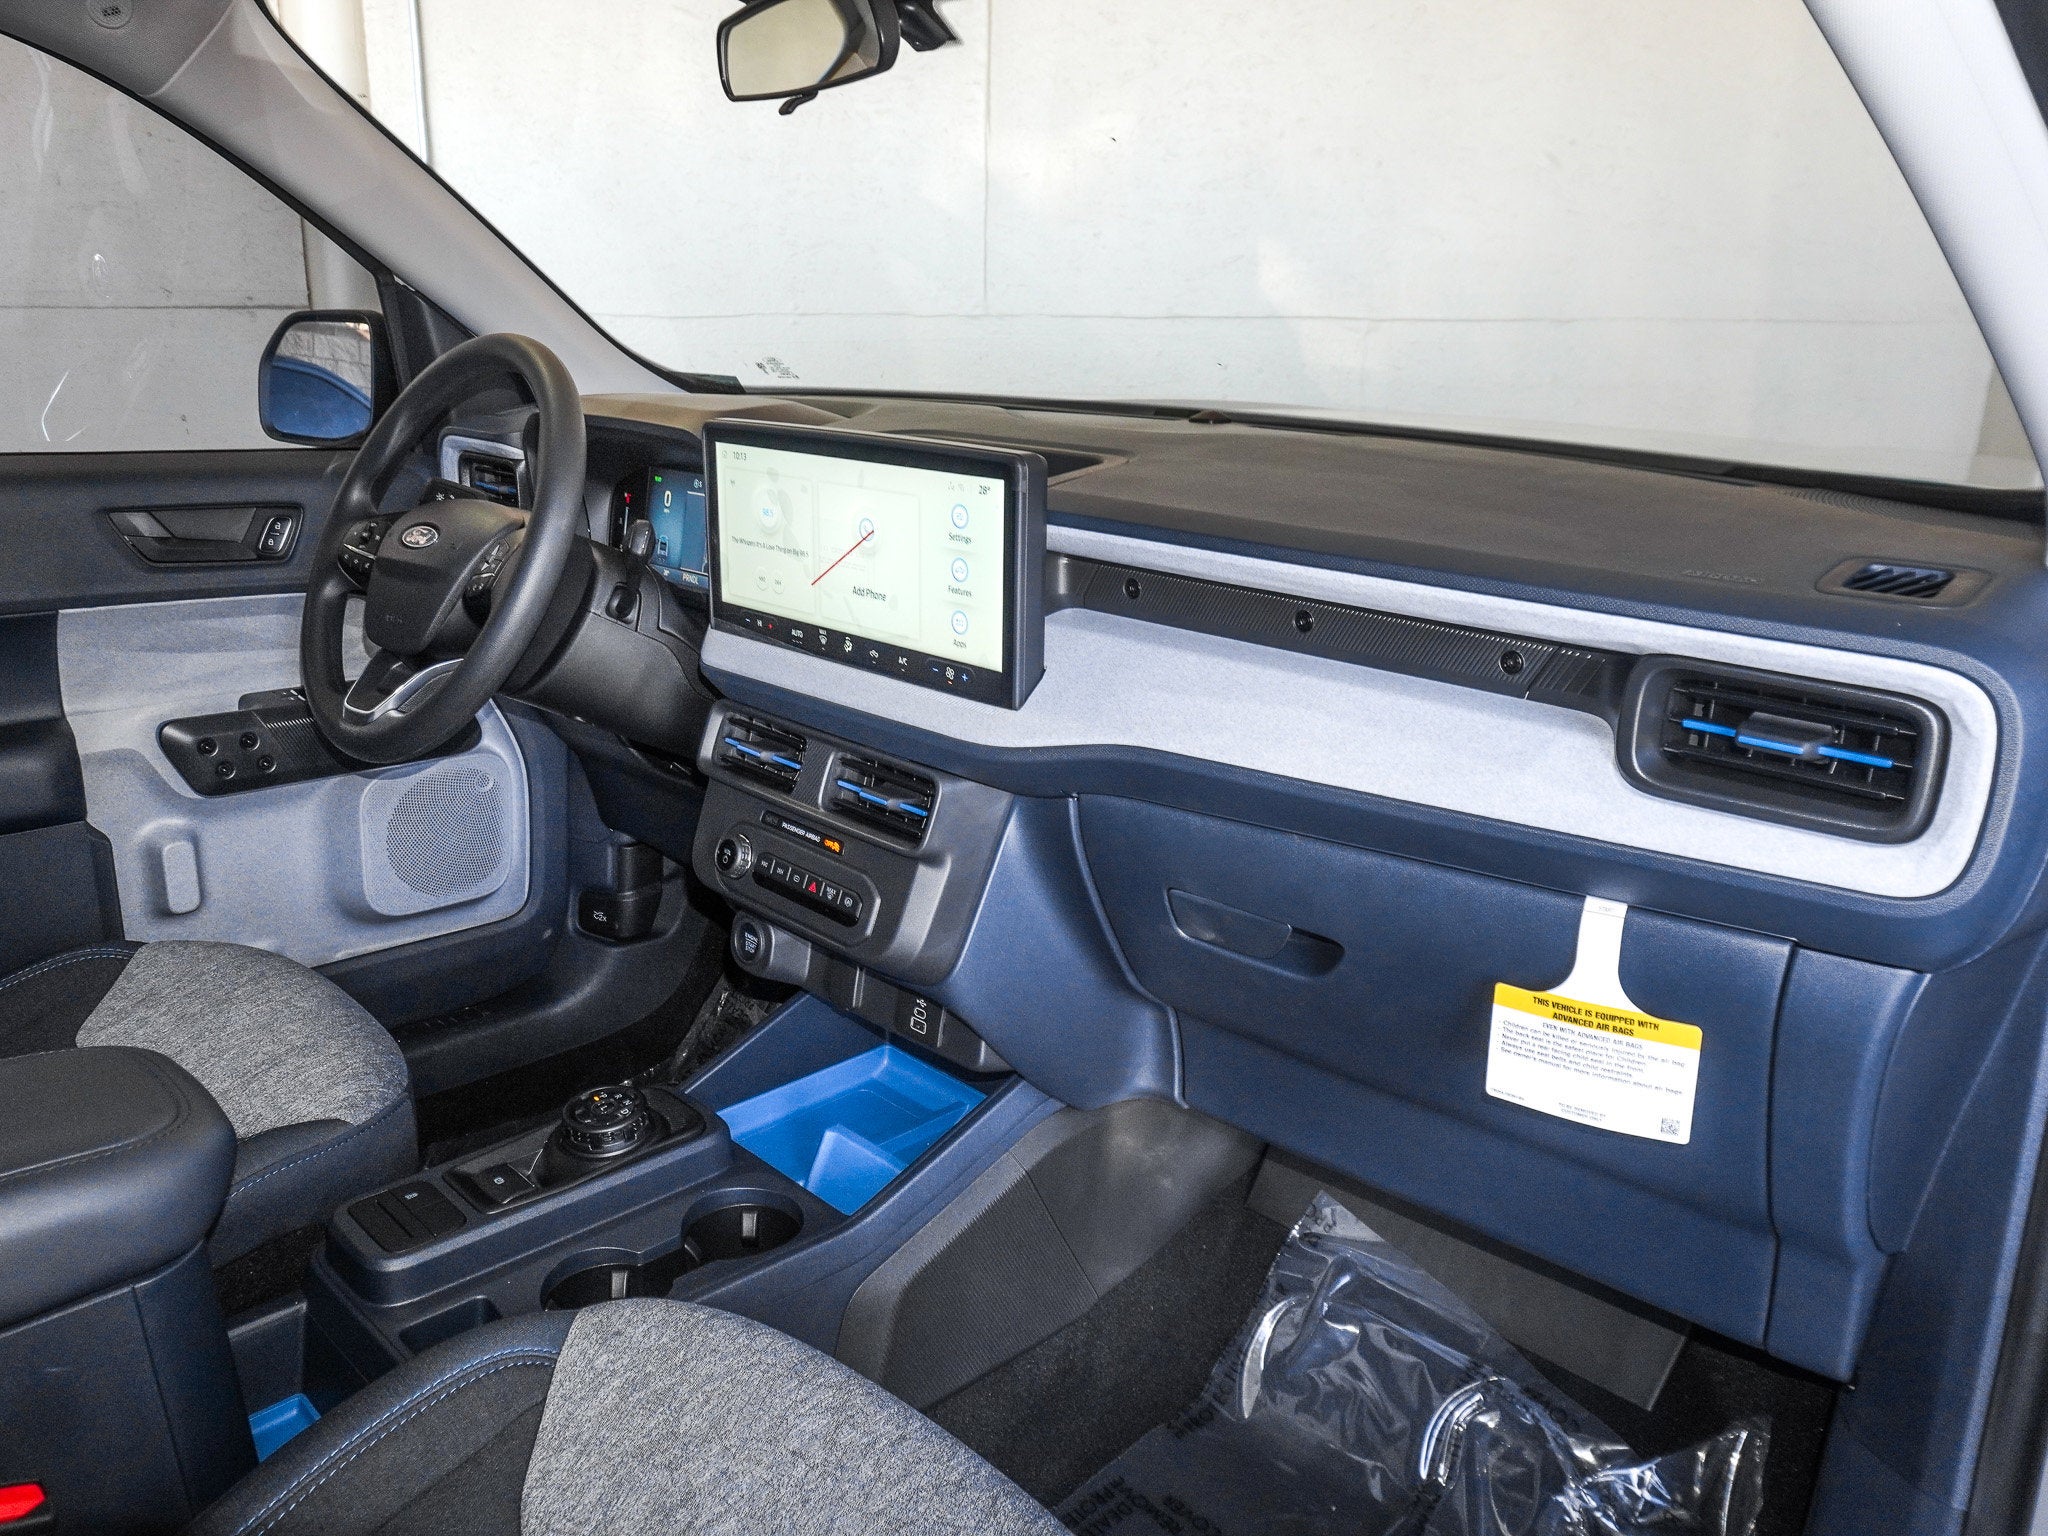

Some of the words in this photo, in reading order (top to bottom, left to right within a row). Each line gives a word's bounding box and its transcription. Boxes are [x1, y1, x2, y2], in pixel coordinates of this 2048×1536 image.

[733, 451, 747, 461] 10:13
[948, 531, 972, 545] Settings
[852, 585, 865, 597] Add
[865, 588, 886, 602] Phone
[948, 585, 972, 597] Features
[953, 638, 967, 649] Apps
[782, 821, 806, 836] PASSENGER
[805, 831, 820, 843] AIRBAG
[1533, 996, 1550, 1007] THIS
[1552, 1001, 1582, 1016] VEHICLE
[1595, 1011, 1635, 1026] EQUIPPED
[1638, 1020, 1660, 1030] WITH
[1543, 1022, 1558, 1031] EVEN
[1560, 1027, 1575, 1035] WITH
[1578, 1031, 1611, 1043] ADVANCED
[1553, 1012, 1594, 1029] ADVANCED
[1596, 1023, 1610, 1031] AIR
[1613, 1026, 1634, 1036] BAGS
